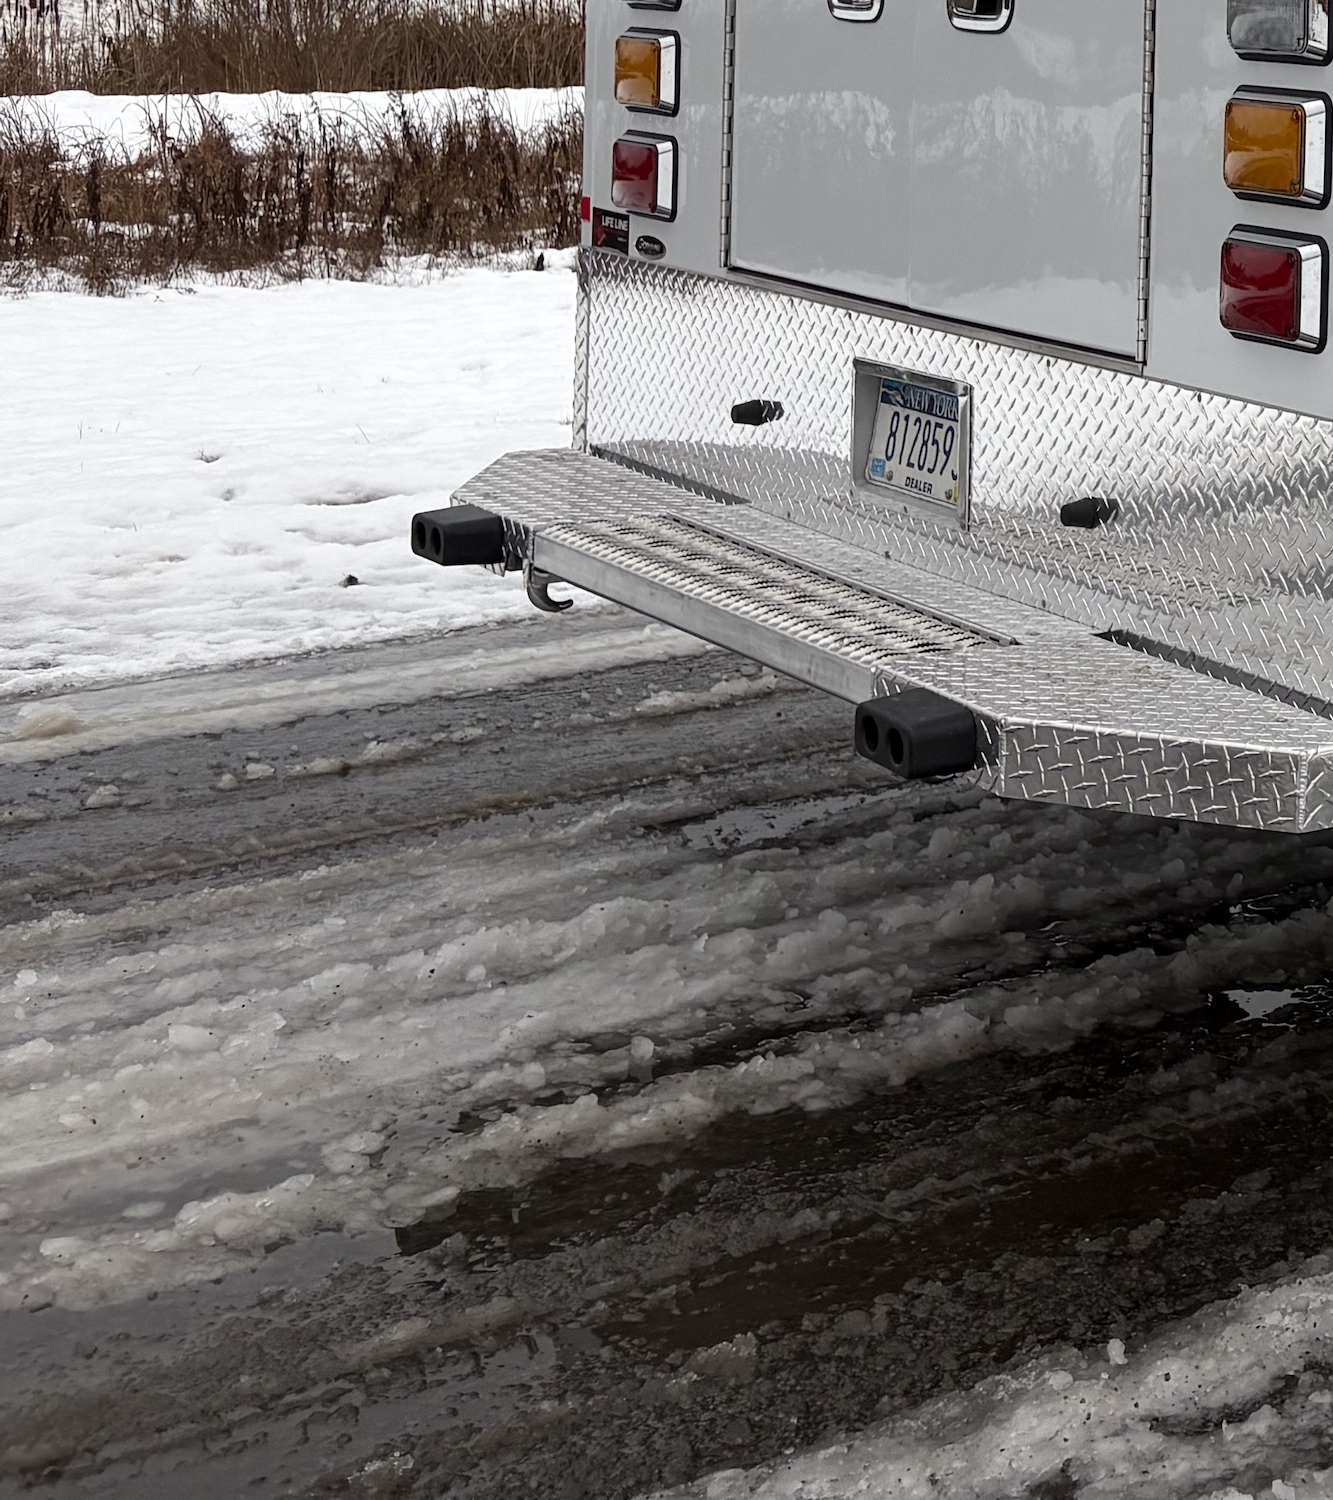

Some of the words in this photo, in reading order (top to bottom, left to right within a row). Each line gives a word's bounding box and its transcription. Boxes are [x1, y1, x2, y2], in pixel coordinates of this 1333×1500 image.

[601, 214, 615, 229] LIFE
[614, 217, 629, 231] LINE
[904, 386, 929, 412] NEW
[929, 390, 958, 419] YORK
[885, 411, 956, 476] 812859
[904, 475, 933, 495] DEALER
